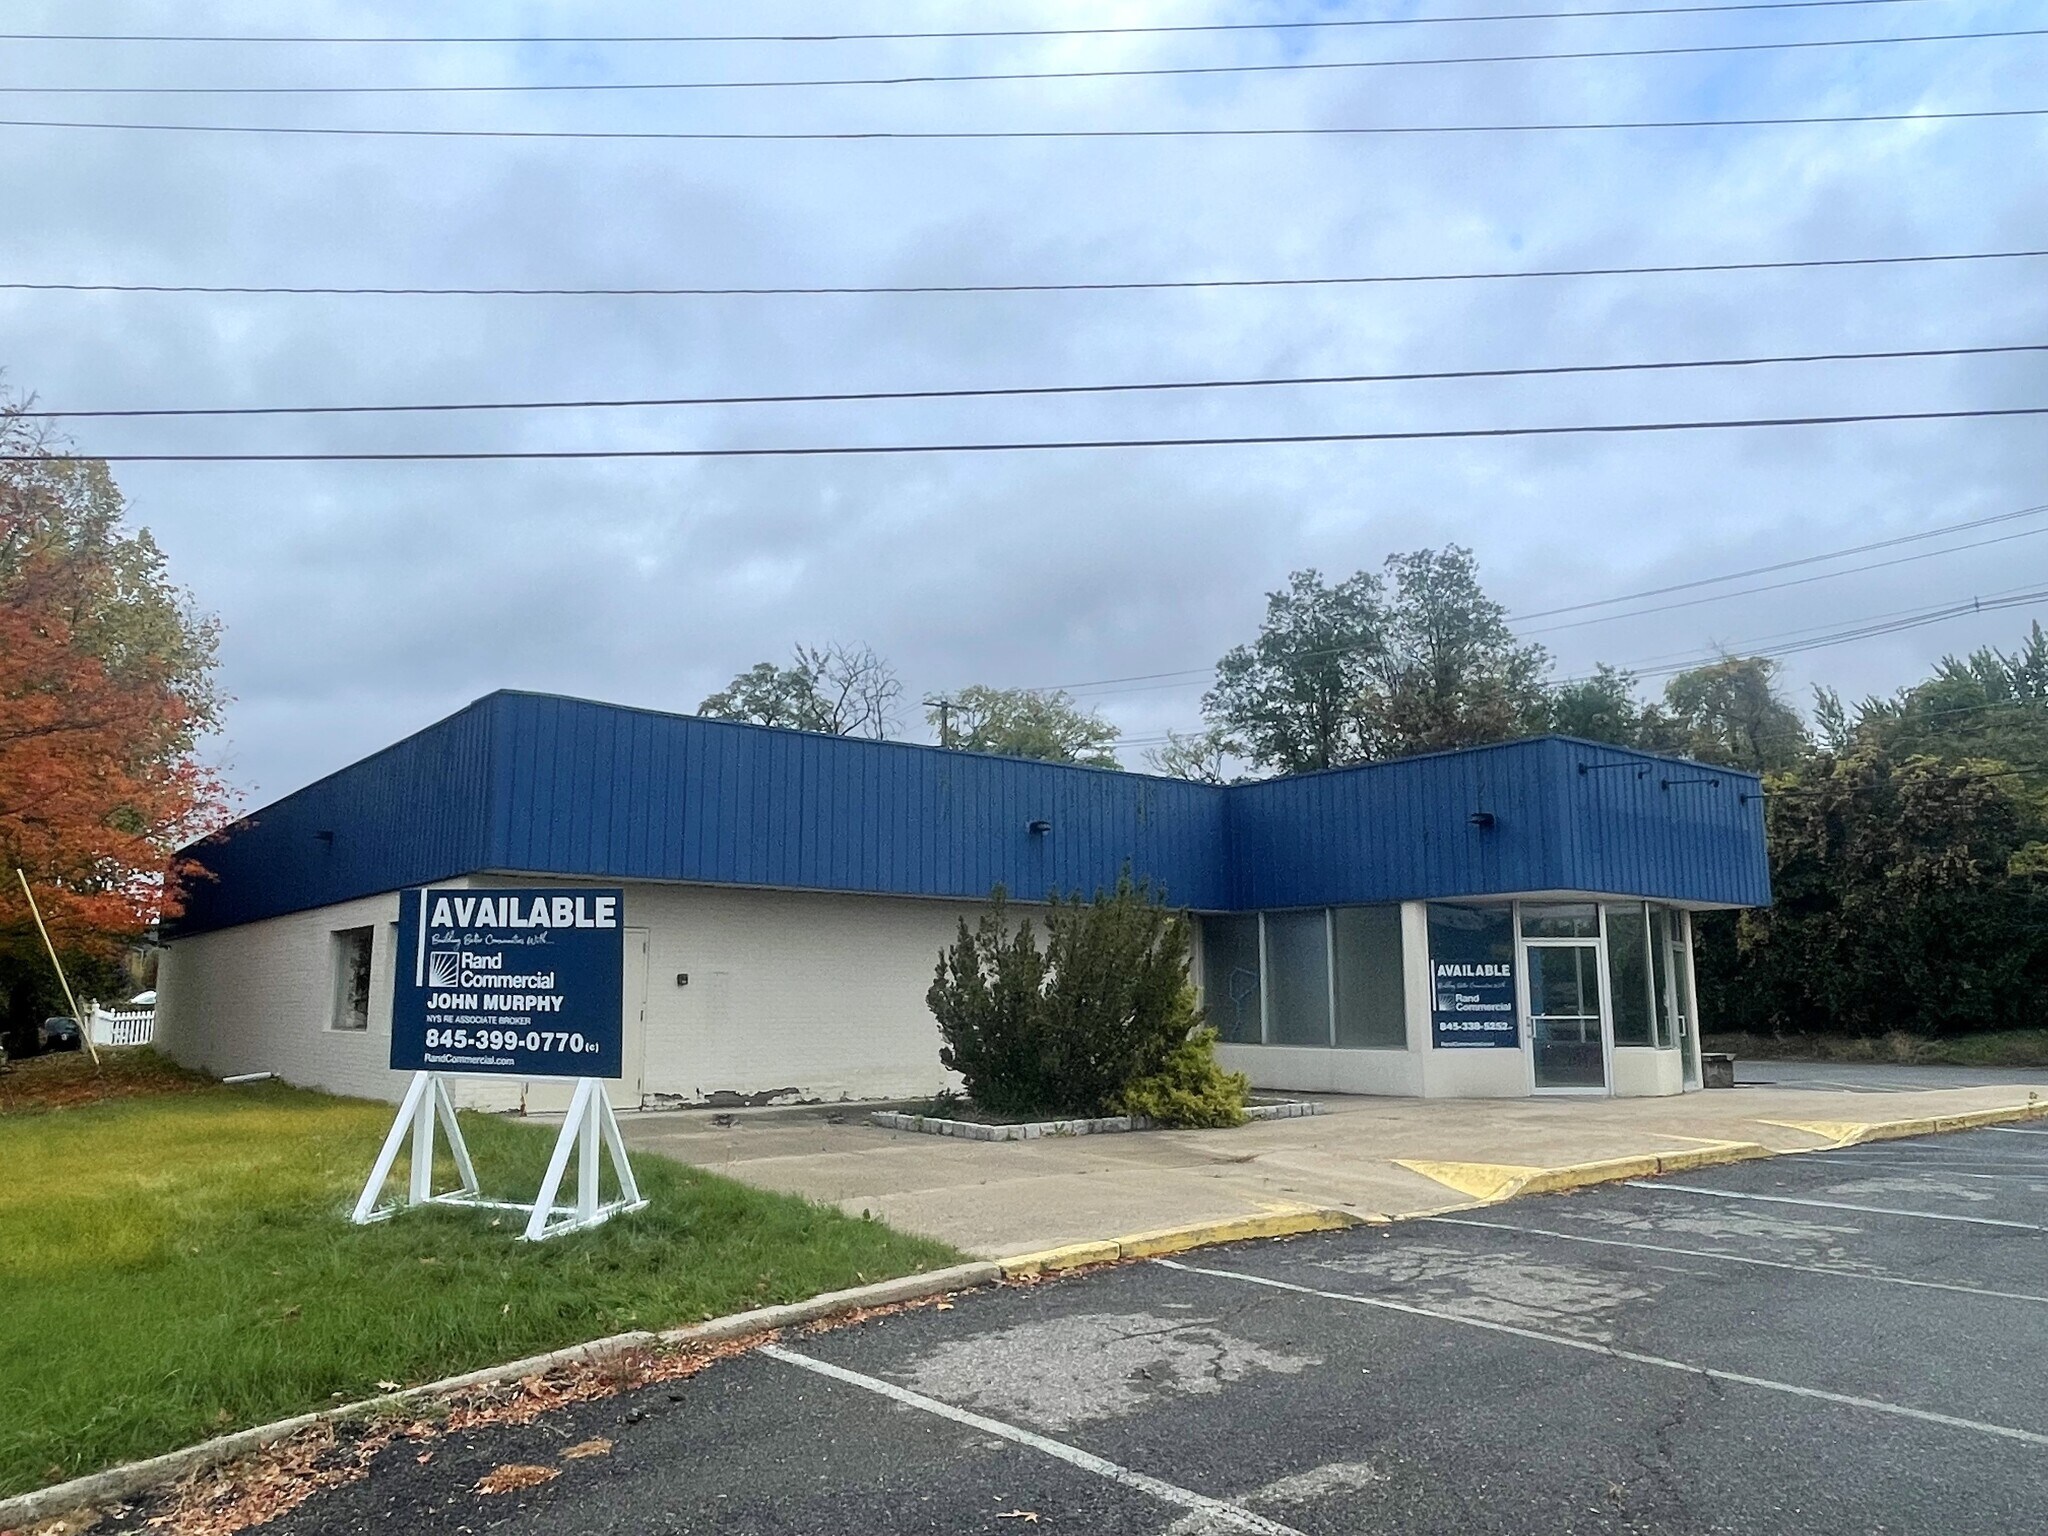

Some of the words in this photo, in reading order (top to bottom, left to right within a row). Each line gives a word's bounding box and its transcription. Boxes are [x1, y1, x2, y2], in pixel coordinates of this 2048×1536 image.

[430, 896, 617, 929] AVAILABLE
[461, 951, 502, 970] Rand
[1437, 964, 1511, 977] AVAILABLE
[460, 971, 555, 989] Commercial
[426, 992, 478, 1010] JOHN
[483, 994, 564, 1012] MURPHY
[1455, 993, 1480, 1003] Rand
[1455, 1002, 1512, 1012] Commercial
[426, 1014, 442, 1023] NYS
[455, 1015, 498, 1025] ASSOCIATE
[498, 1016, 532, 1026] BROKER
[425, 1028, 584, 1052] 845-399-0770
[424, 1052, 515, 1066] RandCommercial.com
